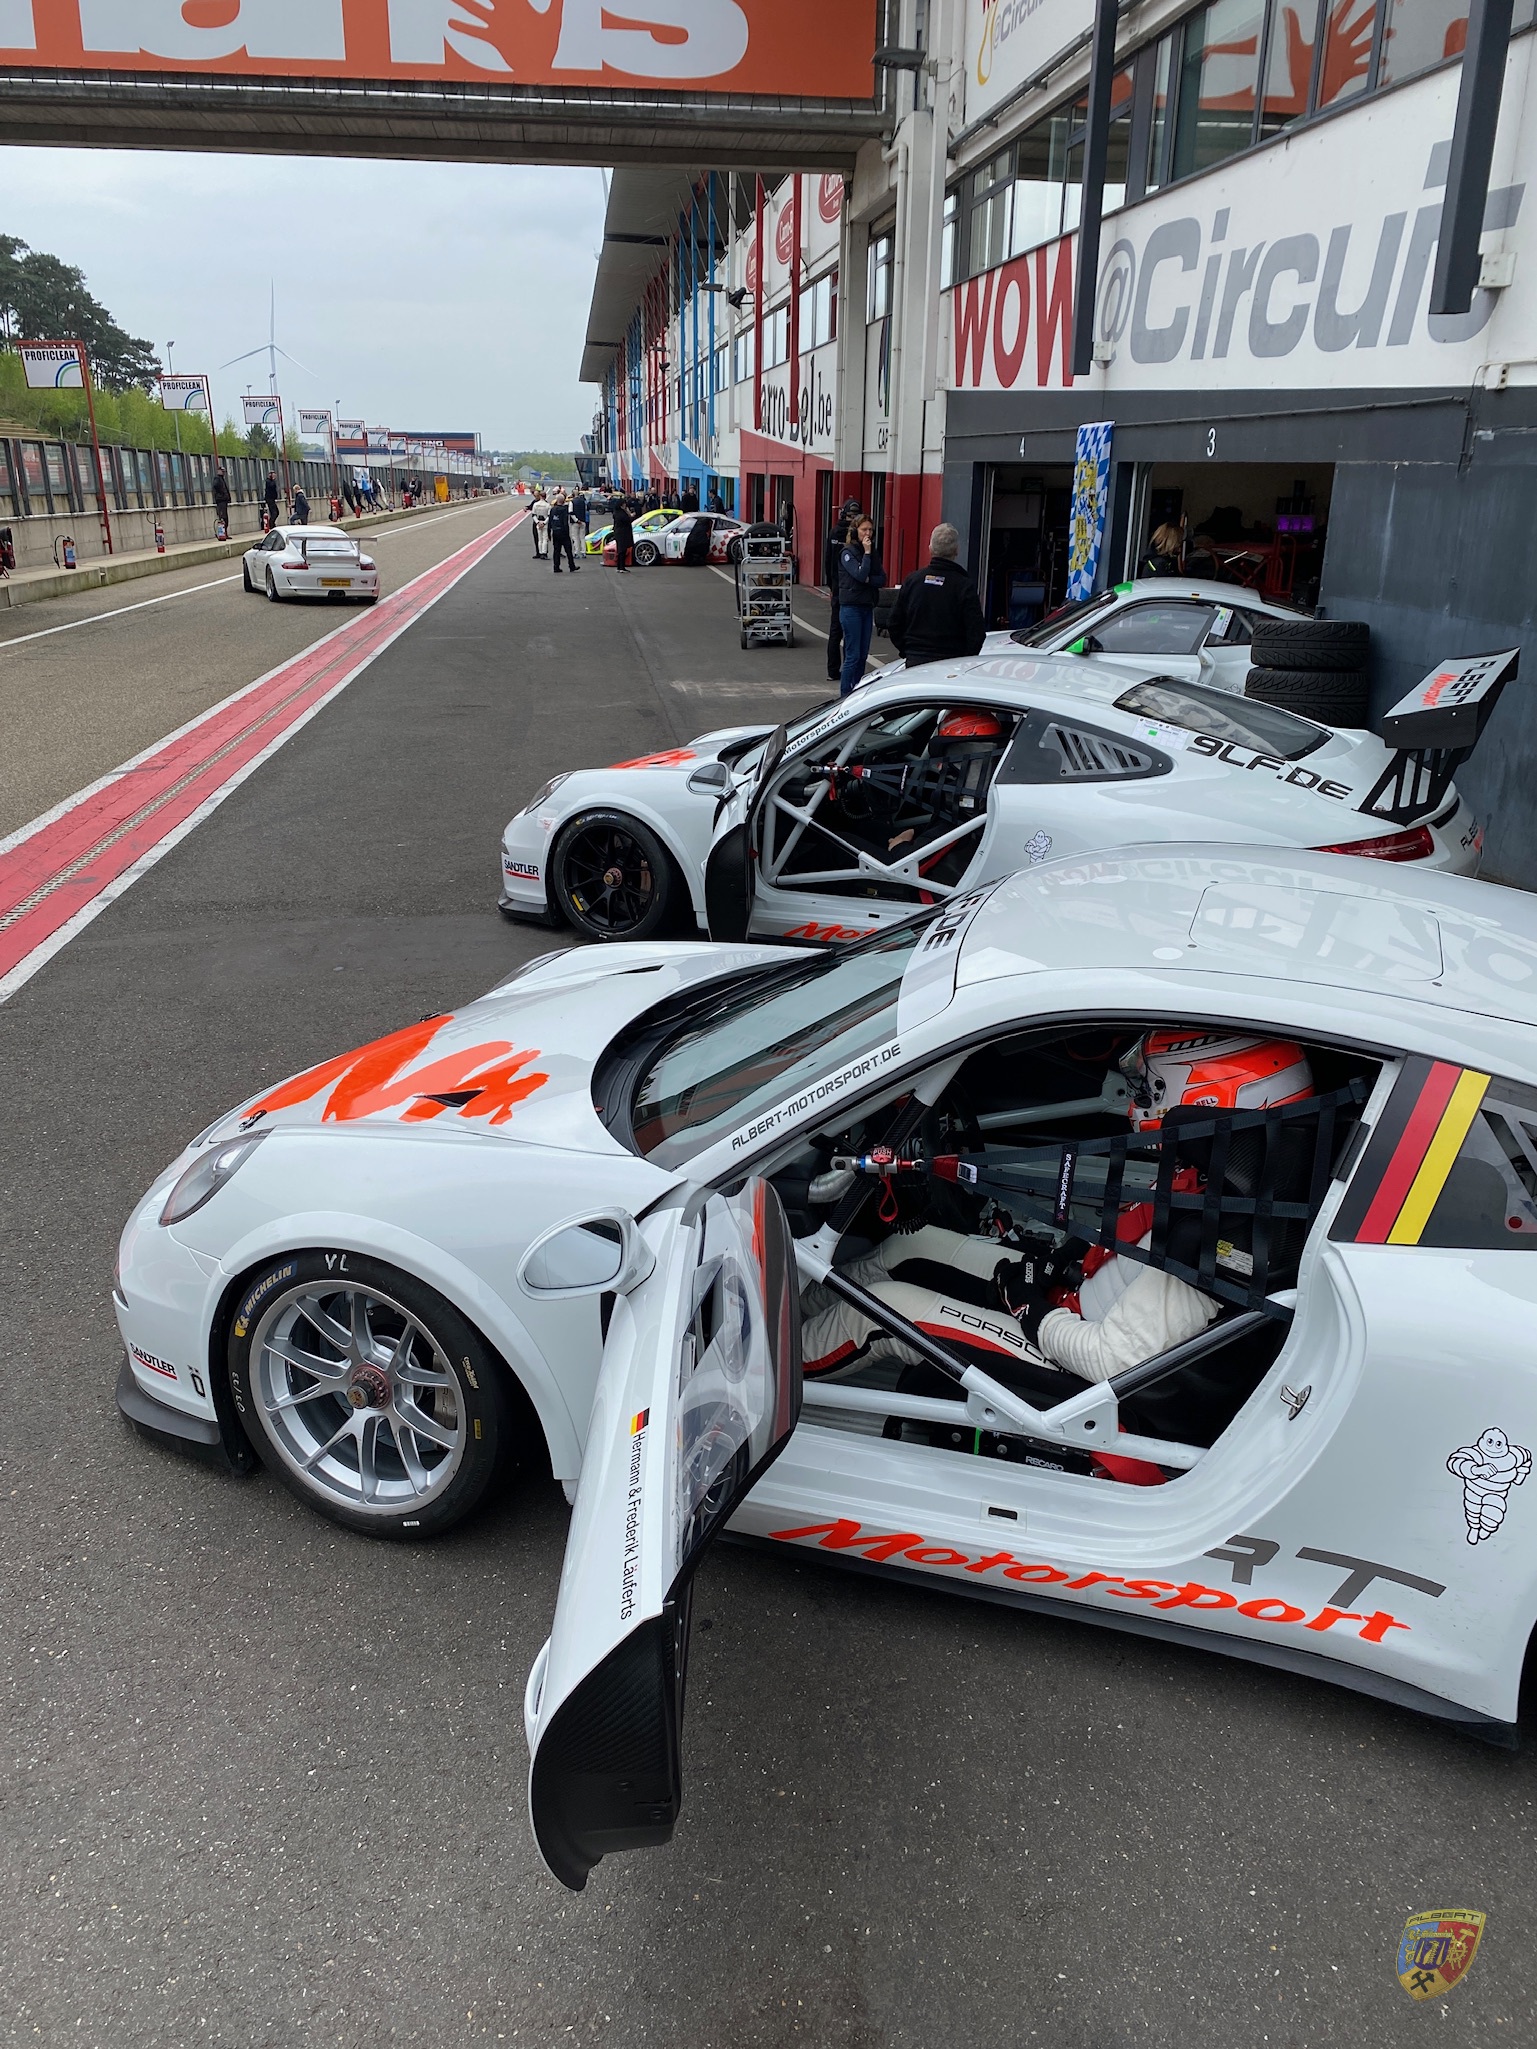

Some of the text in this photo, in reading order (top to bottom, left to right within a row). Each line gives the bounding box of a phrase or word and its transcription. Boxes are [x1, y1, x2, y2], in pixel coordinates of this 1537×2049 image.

[25, 349, 76, 361] PROFICLEAN
[163, 381, 202, 390] PROFICLEAN
[1018, 437, 1026, 458] 4
[1207, 427, 1216, 457] 3
[1186, 736, 1354, 800] 9LF.DE
[504, 859, 539, 876] SANDTLER
[732, 1043, 901, 1151] ALBERT-MOTORSPORT.DE
[873, 1148, 893, 1158] PUSH
[1059, 1153, 1072, 1210] SAFECRAFT
[325, 1253, 349, 1272] VL
[245, 1265, 293, 1315] MICHELIN
[130, 1342, 177, 1375] SANDTLER
[1025, 1456, 1064, 1471] RECARO
[621, 1431, 646, 1620] Hermann & Frederik Läuferts
[769, 1518, 1412, 1643] Motorsport
